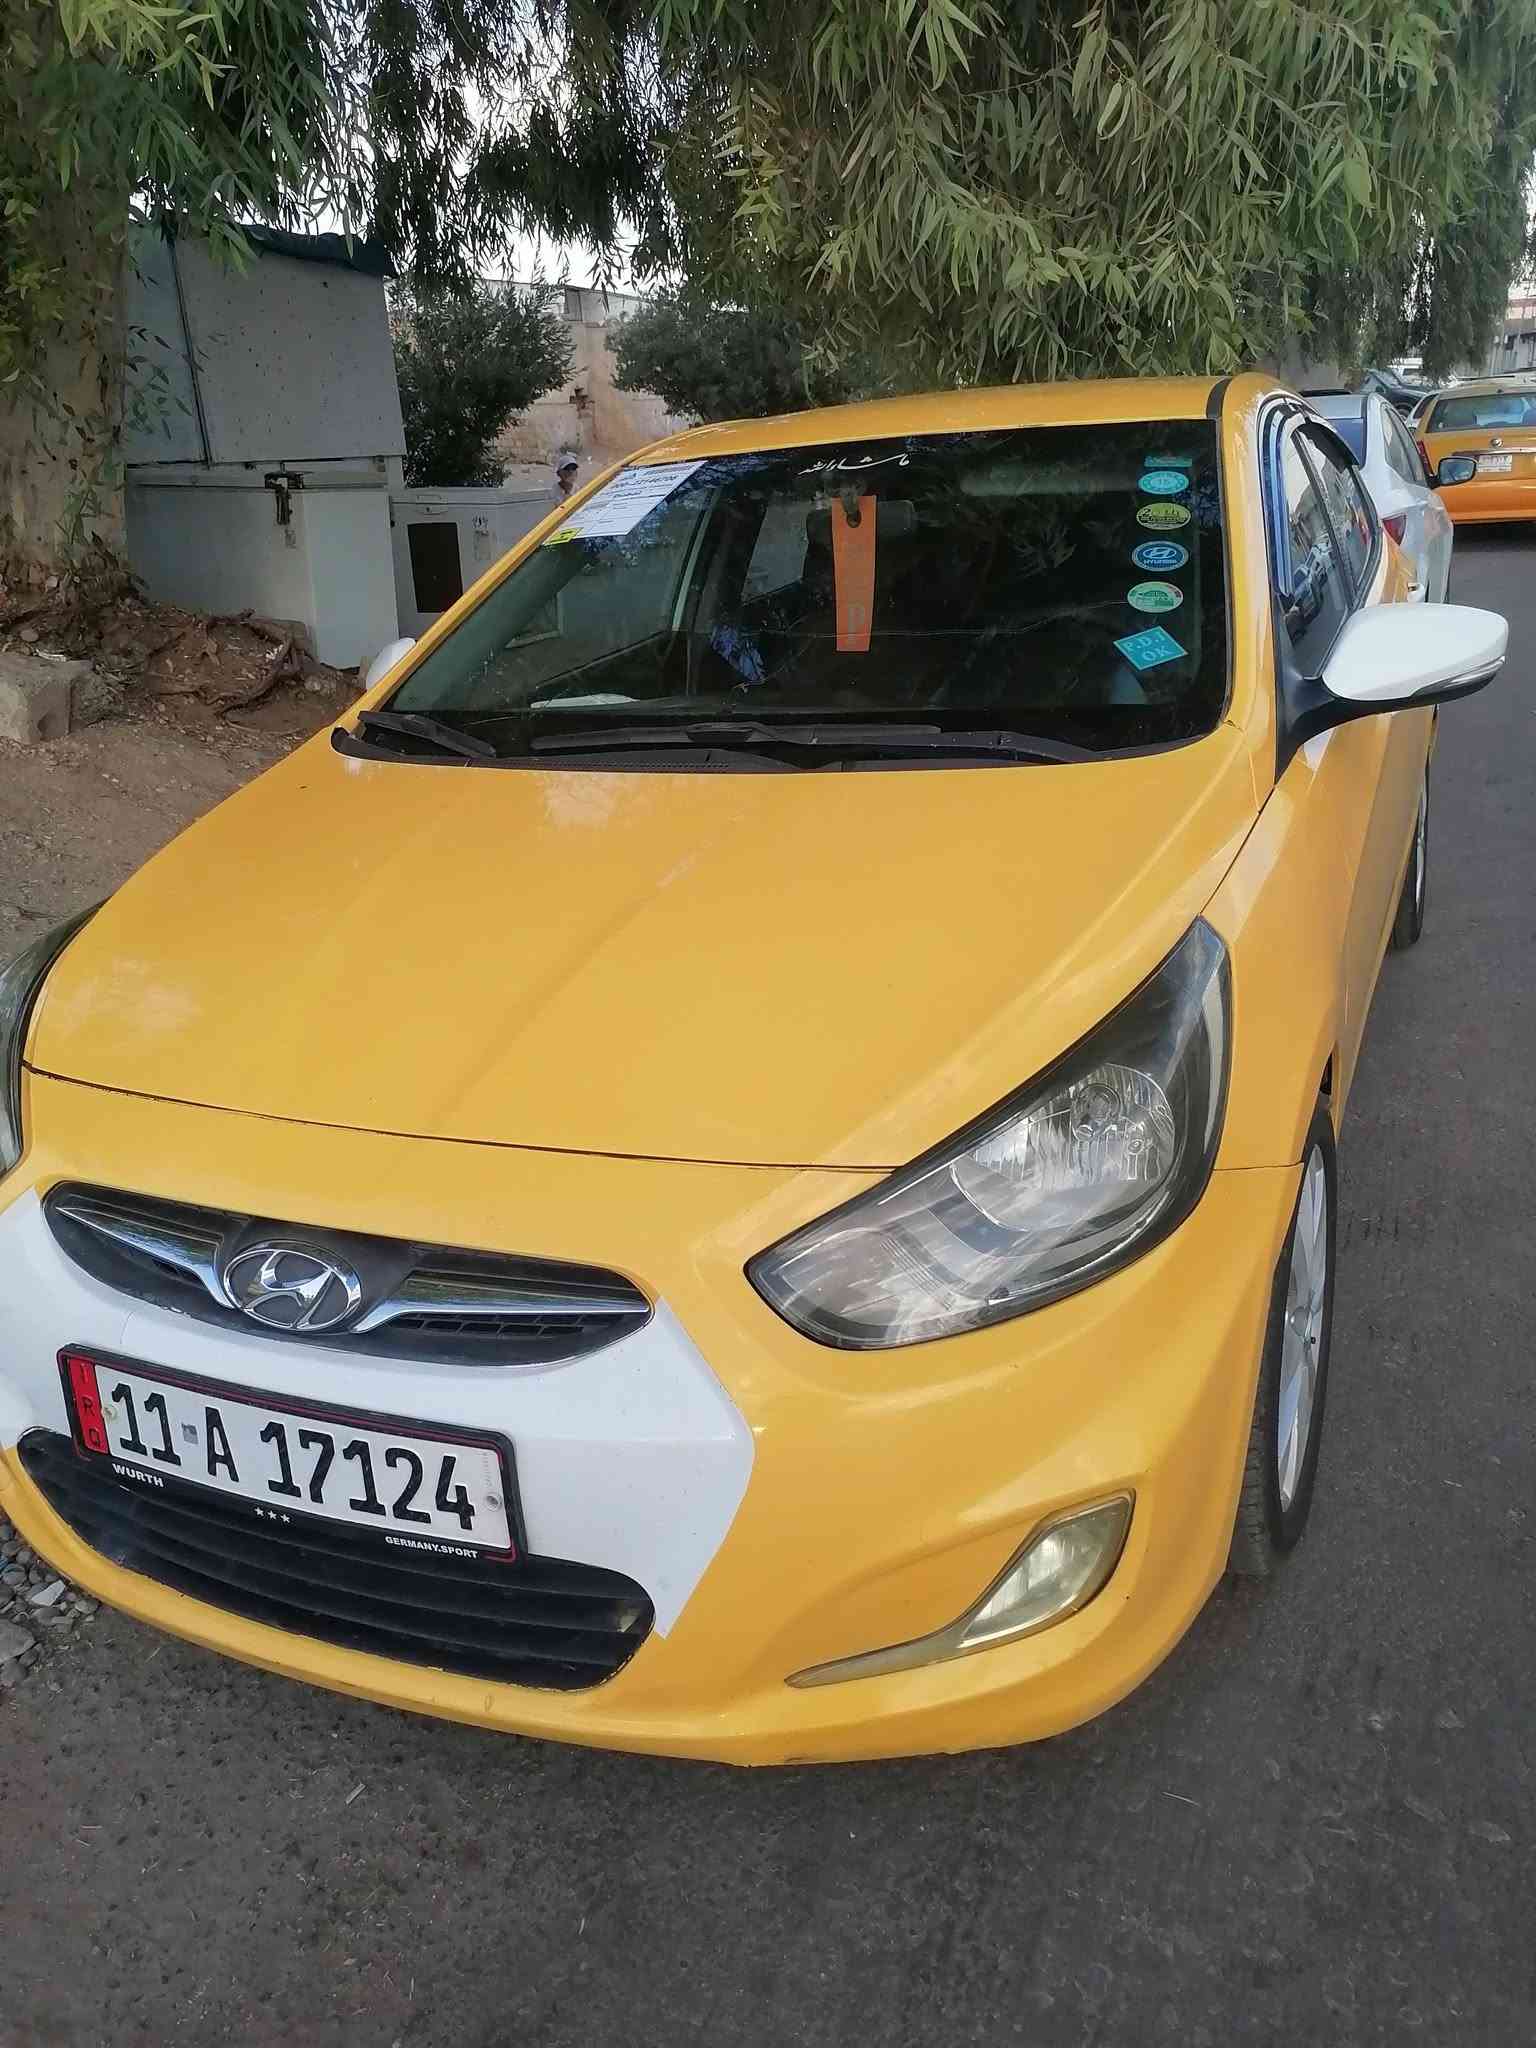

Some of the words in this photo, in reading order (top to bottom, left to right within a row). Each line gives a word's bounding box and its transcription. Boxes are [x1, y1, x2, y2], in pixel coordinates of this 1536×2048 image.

[111, 1382, 182, 1467] 11
[205, 1406, 240, 1482] A
[259, 1421, 476, 1531] 17124
[111, 1462, 165, 1489] WURTH
[384, 1535, 479, 1560] GERMANY.SPORT
